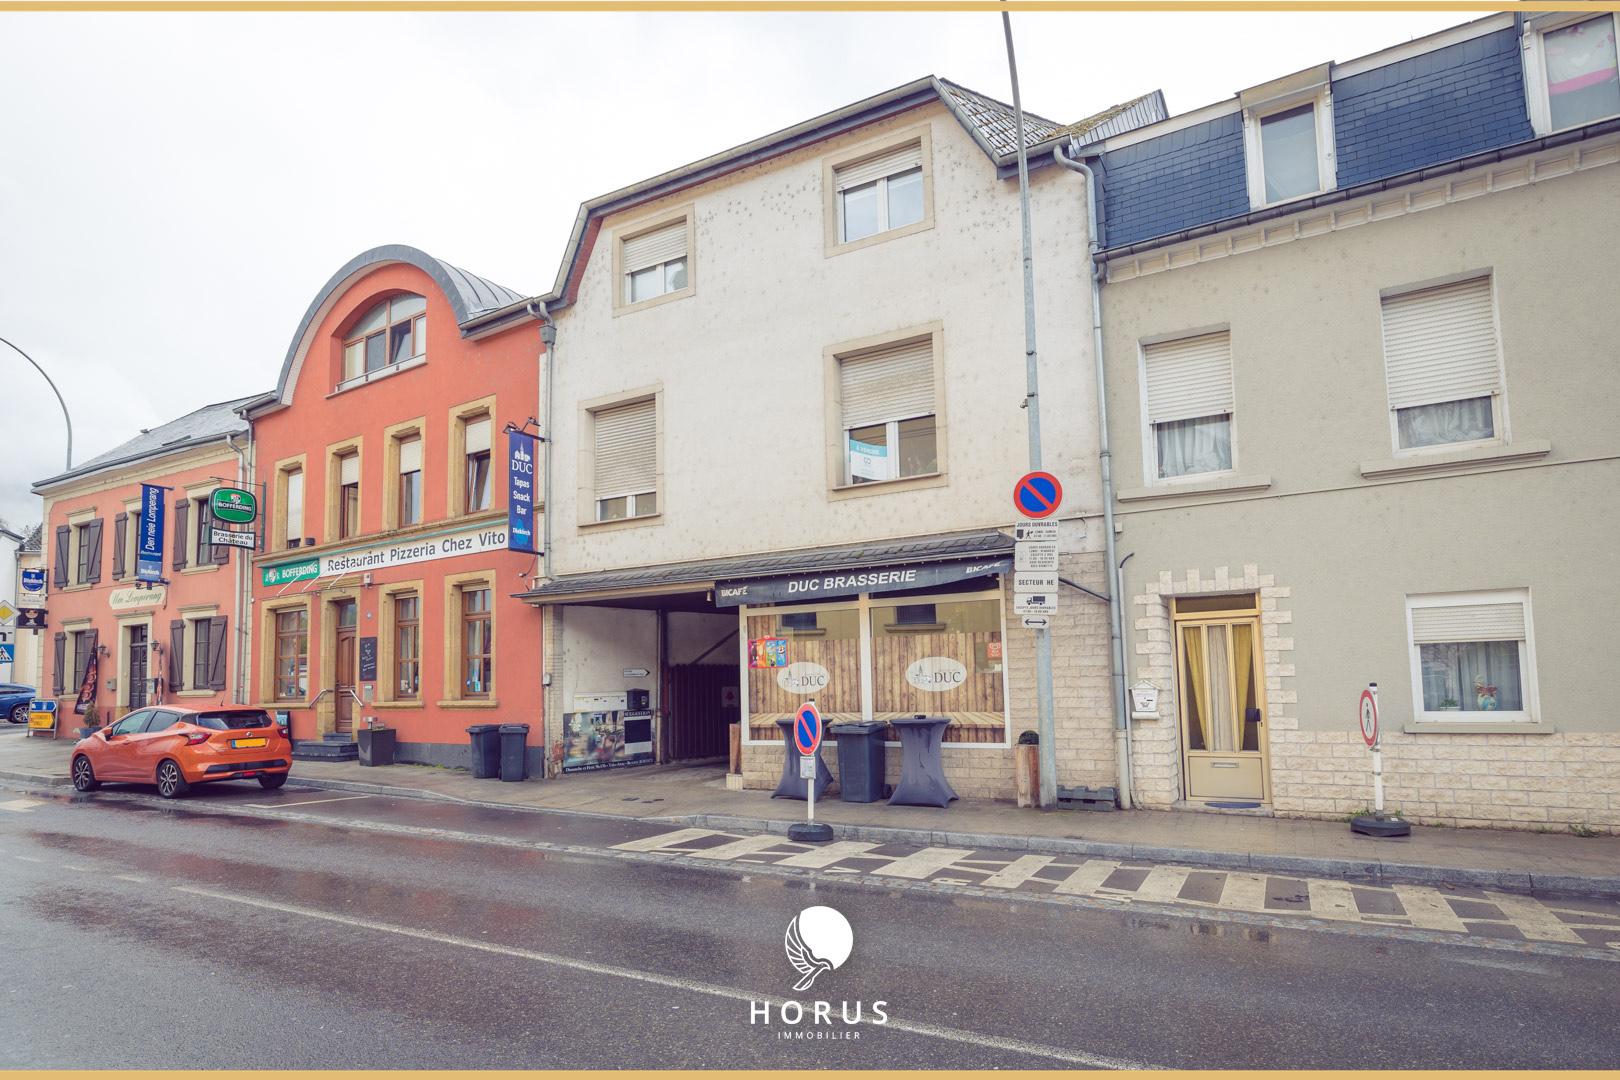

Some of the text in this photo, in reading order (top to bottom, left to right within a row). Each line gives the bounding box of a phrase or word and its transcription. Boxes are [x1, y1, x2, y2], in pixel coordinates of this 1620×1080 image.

[512, 460, 533, 474] DUC
[514, 477, 530, 488] Tapas
[513, 490, 530, 502] Snack
[218, 502, 252, 512] BOFFERDING
[516, 505, 527, 515] Bar
[214, 531, 244, 540] Brasserie
[218, 537, 248, 546] Château
[328, 530, 506, 572] Restaurant Pizzeria Chez Vito
[282, 564, 318, 578] BOFFERDING
[788, 579, 819, 593] DUC
[824, 570, 917, 590] BRASSERIE
[801, 676, 824, 686] DUC
[934, 672, 961, 683] DUC
